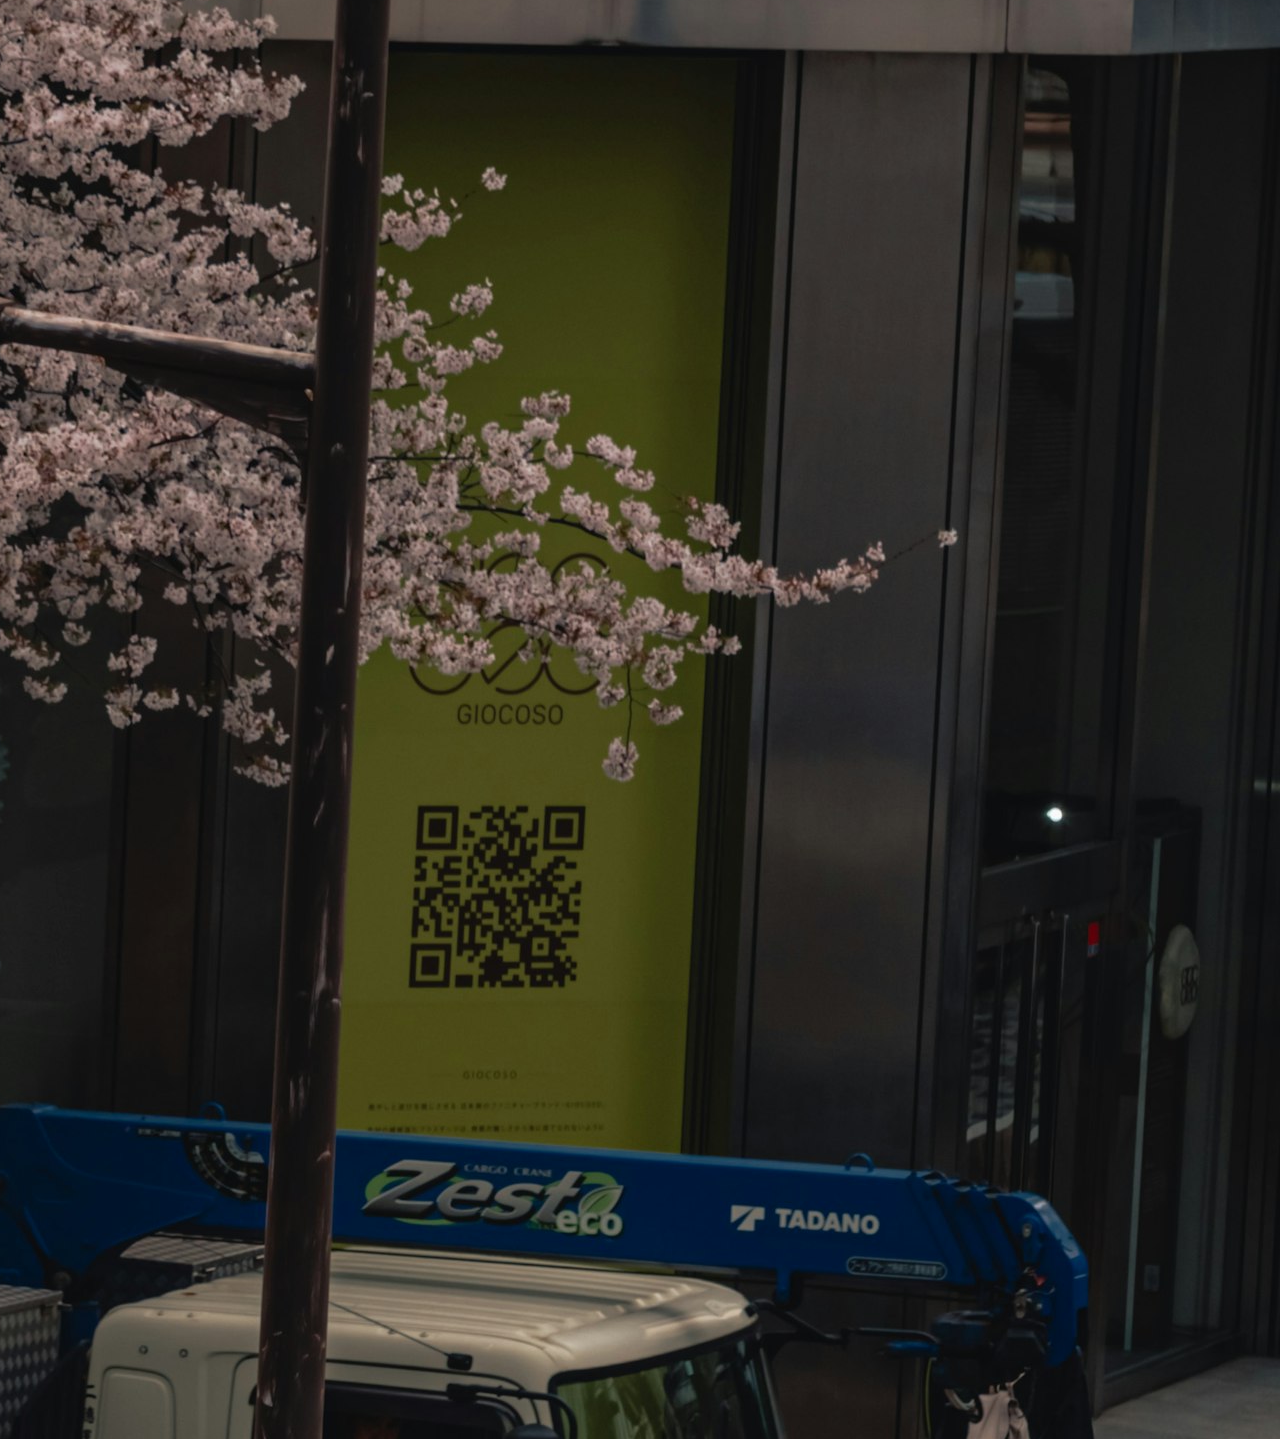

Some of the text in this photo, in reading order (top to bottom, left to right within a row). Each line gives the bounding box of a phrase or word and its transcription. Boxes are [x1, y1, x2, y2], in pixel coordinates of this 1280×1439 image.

[457, 703, 564, 726] GIOCOSO
[462, 1069, 518, 1080] GIOCOSO
[463, 1162, 553, 1178] CARGO CRANE
[361, 1158, 583, 1226] Zest
[555, 1208, 624, 1237] eco
[774, 1207, 880, 1236] TADANO
